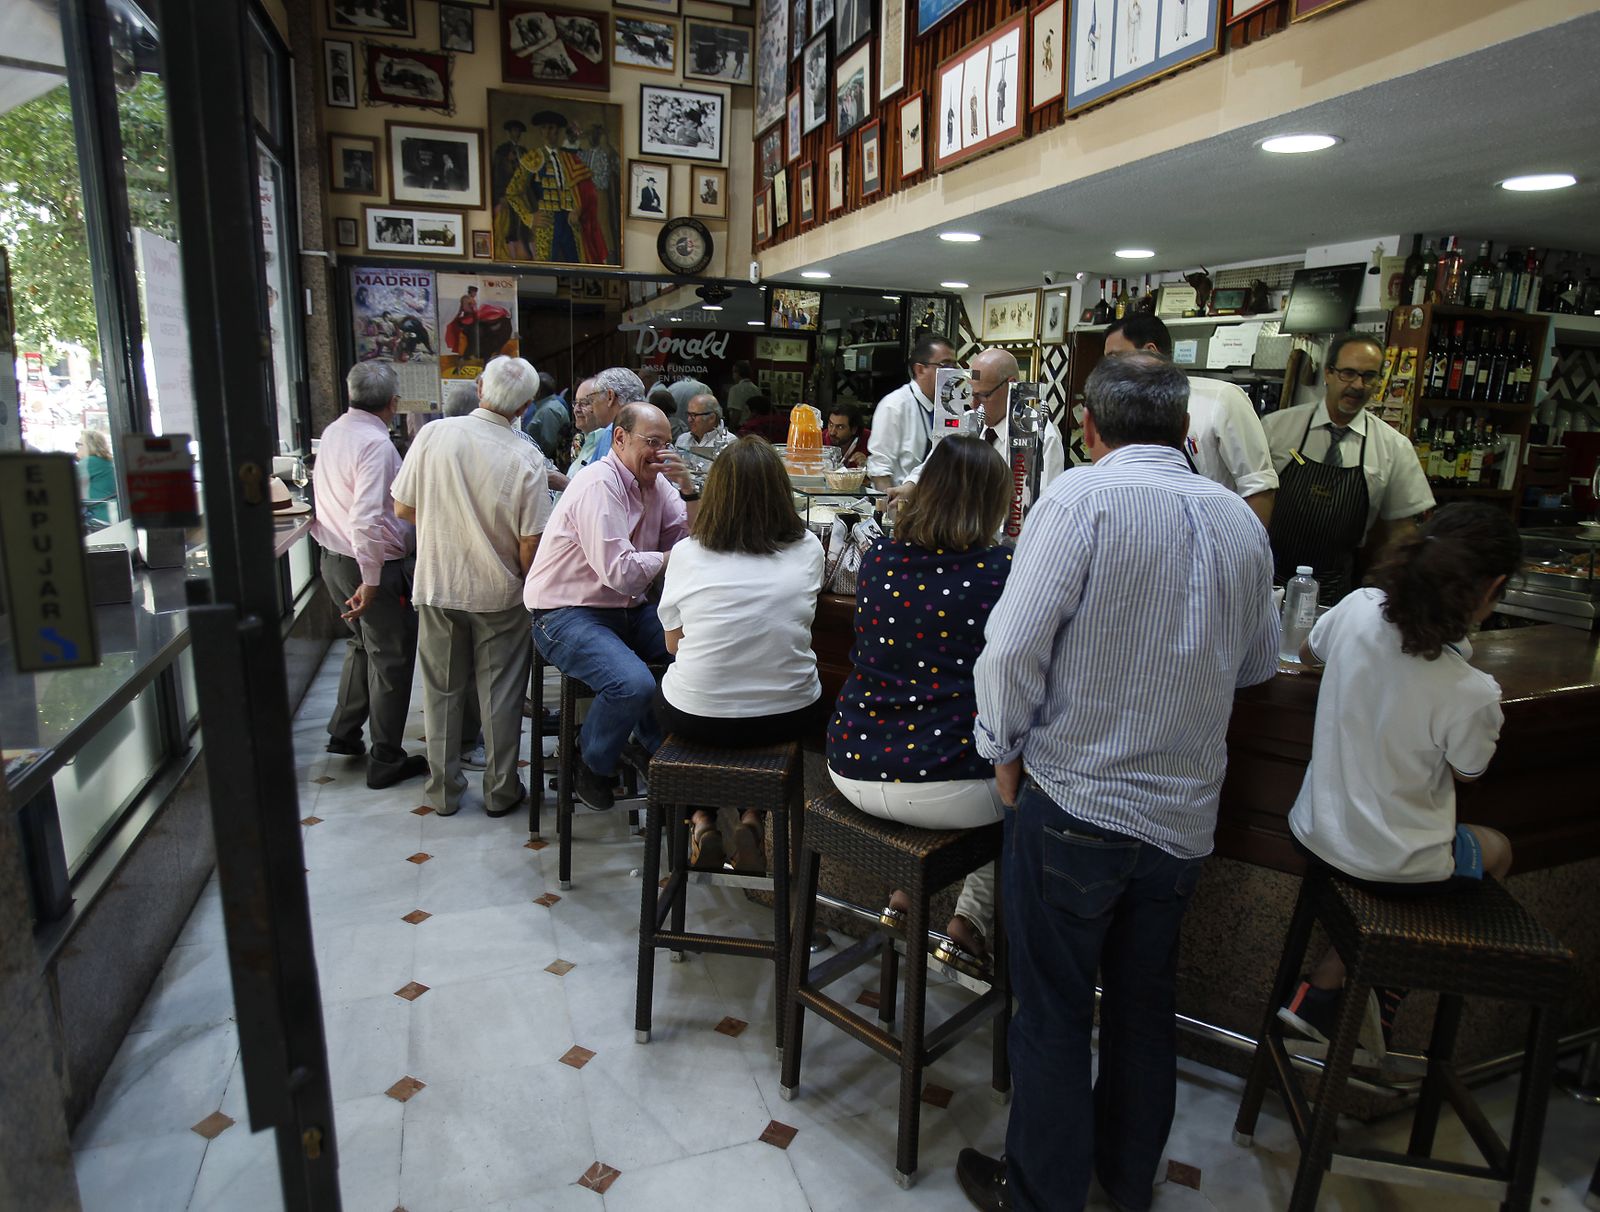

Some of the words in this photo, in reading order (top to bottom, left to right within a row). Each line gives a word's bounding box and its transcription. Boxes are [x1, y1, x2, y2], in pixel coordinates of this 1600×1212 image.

[355, 275, 431, 287] MADRID
[617, 323, 730, 360] Donald
[667, 364, 709, 374] FUNDADA
[1012, 438, 1028, 447] SIN
[24, 464, 62, 620] EMPUJAR
